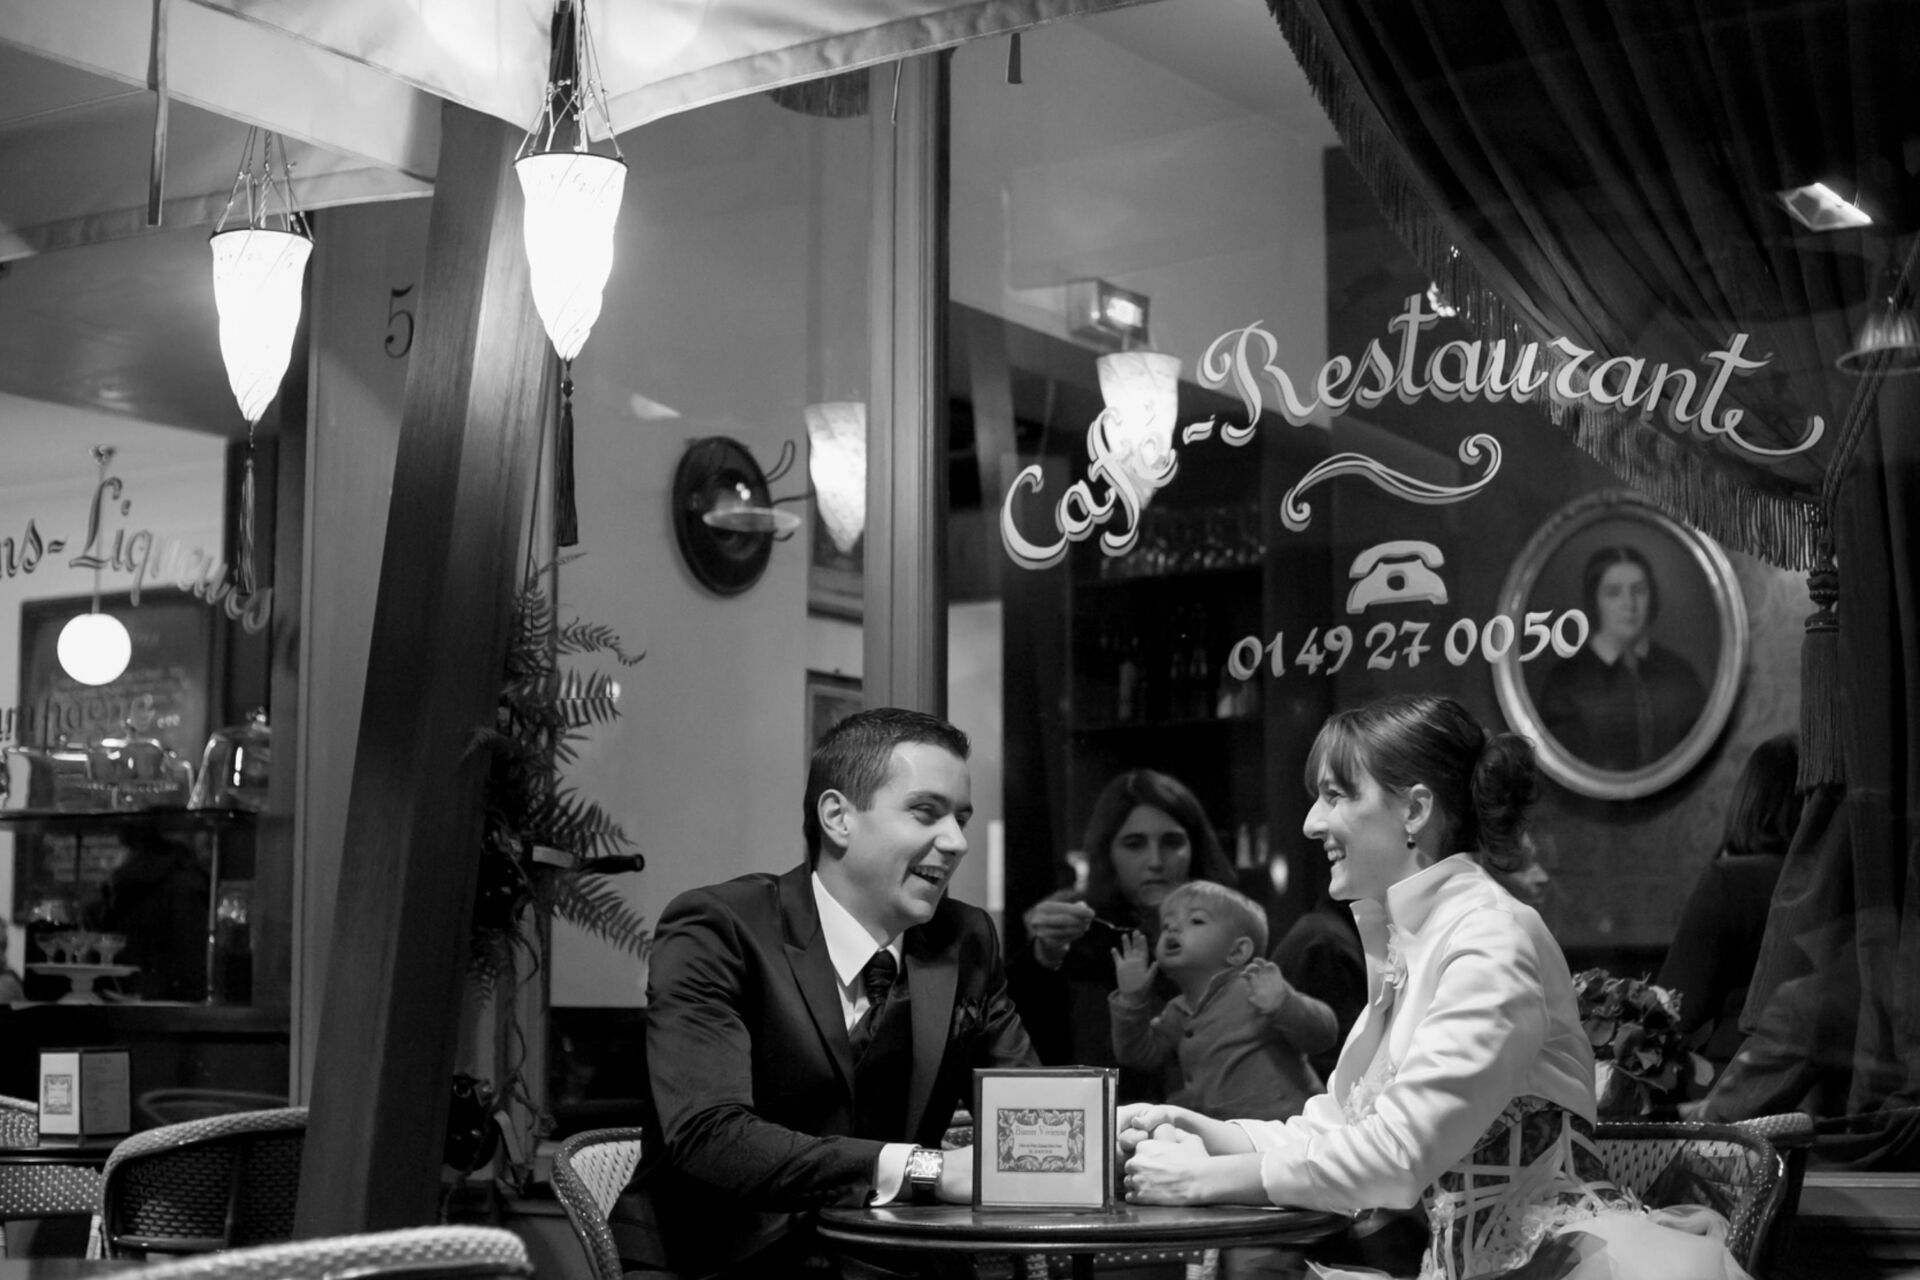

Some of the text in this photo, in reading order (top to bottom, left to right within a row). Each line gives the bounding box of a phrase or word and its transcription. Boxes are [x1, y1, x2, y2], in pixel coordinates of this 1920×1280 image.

[384, 283, 415, 359] 5
[1227, 631, 1285, 681] 01
[1295, 626, 1353, 676] 49
[1365, 620, 1431, 671] 27
